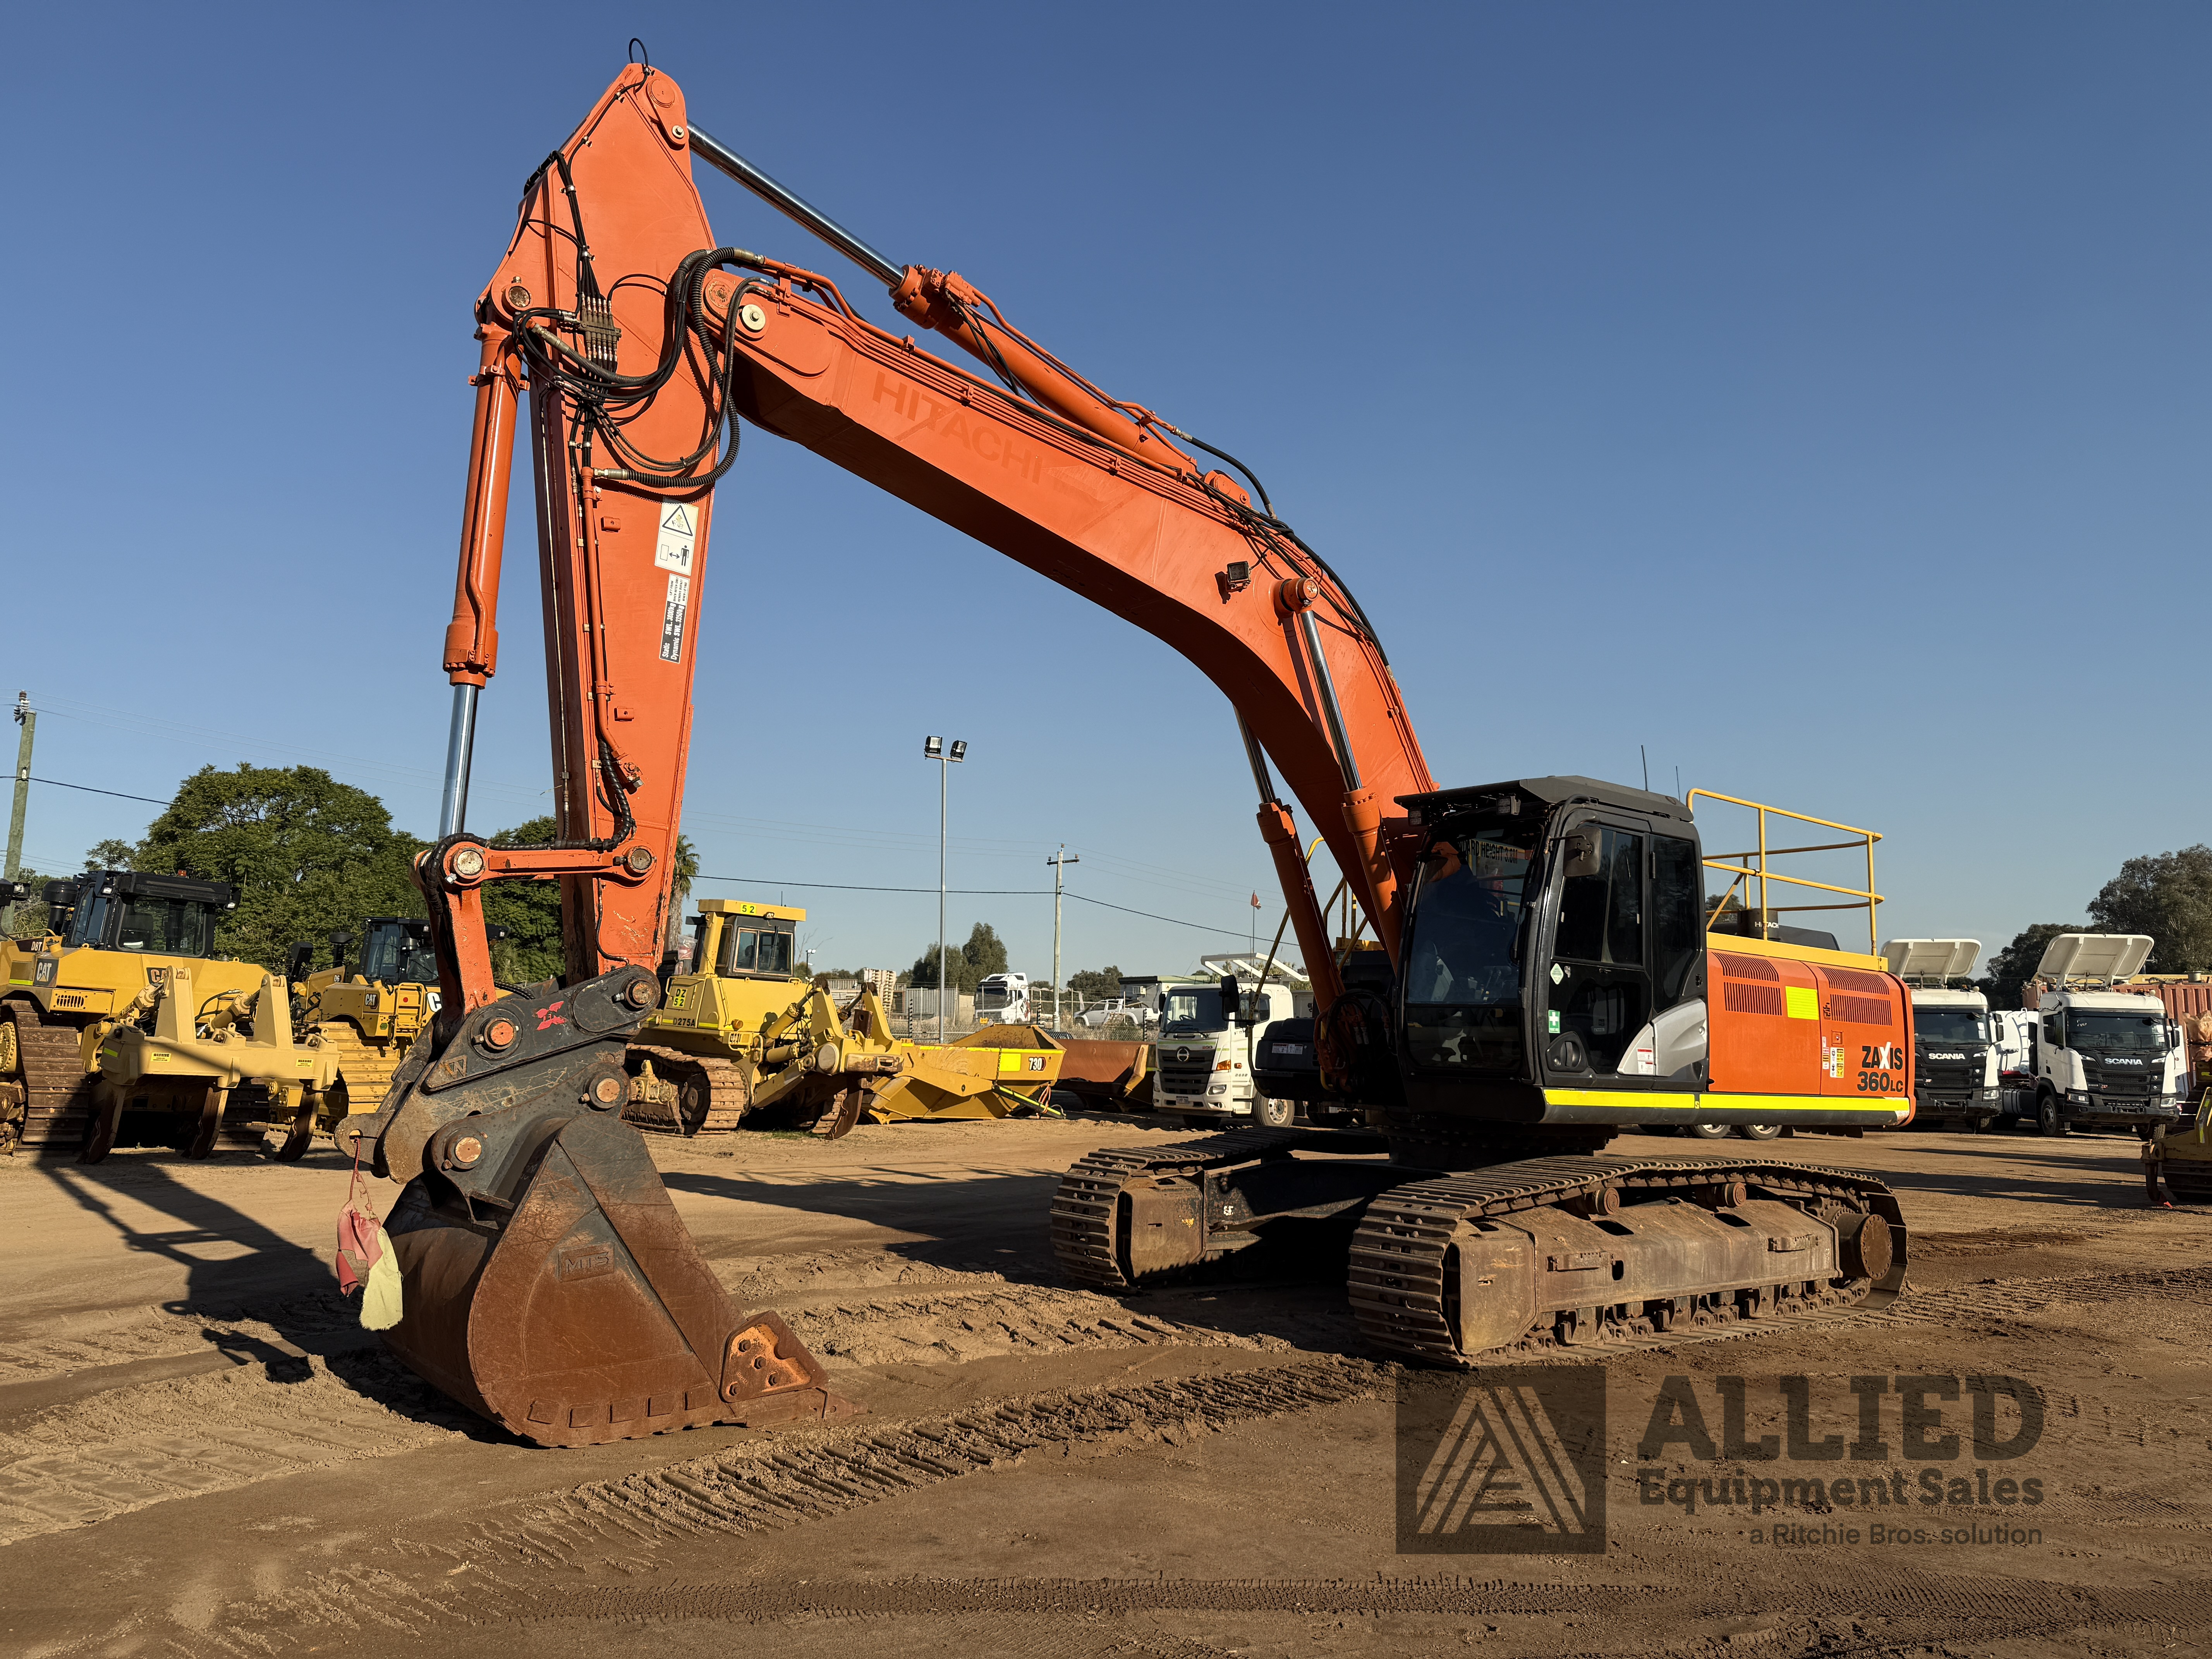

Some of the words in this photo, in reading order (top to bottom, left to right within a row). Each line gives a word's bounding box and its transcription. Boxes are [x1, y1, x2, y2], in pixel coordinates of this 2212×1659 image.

[872, 376, 1042, 484] HITACHI
[662, 642, 670, 658] Static
[670, 637, 680, 660] Dynamic
[1482, 842, 1503, 860] HEIGHT
[31, 941, 42, 951] D8T
[37, 962, 52, 982] CAT
[365, 994, 376, 1006] CAT
[676, 989, 687, 998] DZ
[674, 998, 684, 1006] 52
[673, 1017, 696, 1027] D275A
[1862, 1041, 1903, 1070] ZAXIS
[1029, 1058, 1042, 1070] 730
[565, 1251, 609, 1273] MTS
